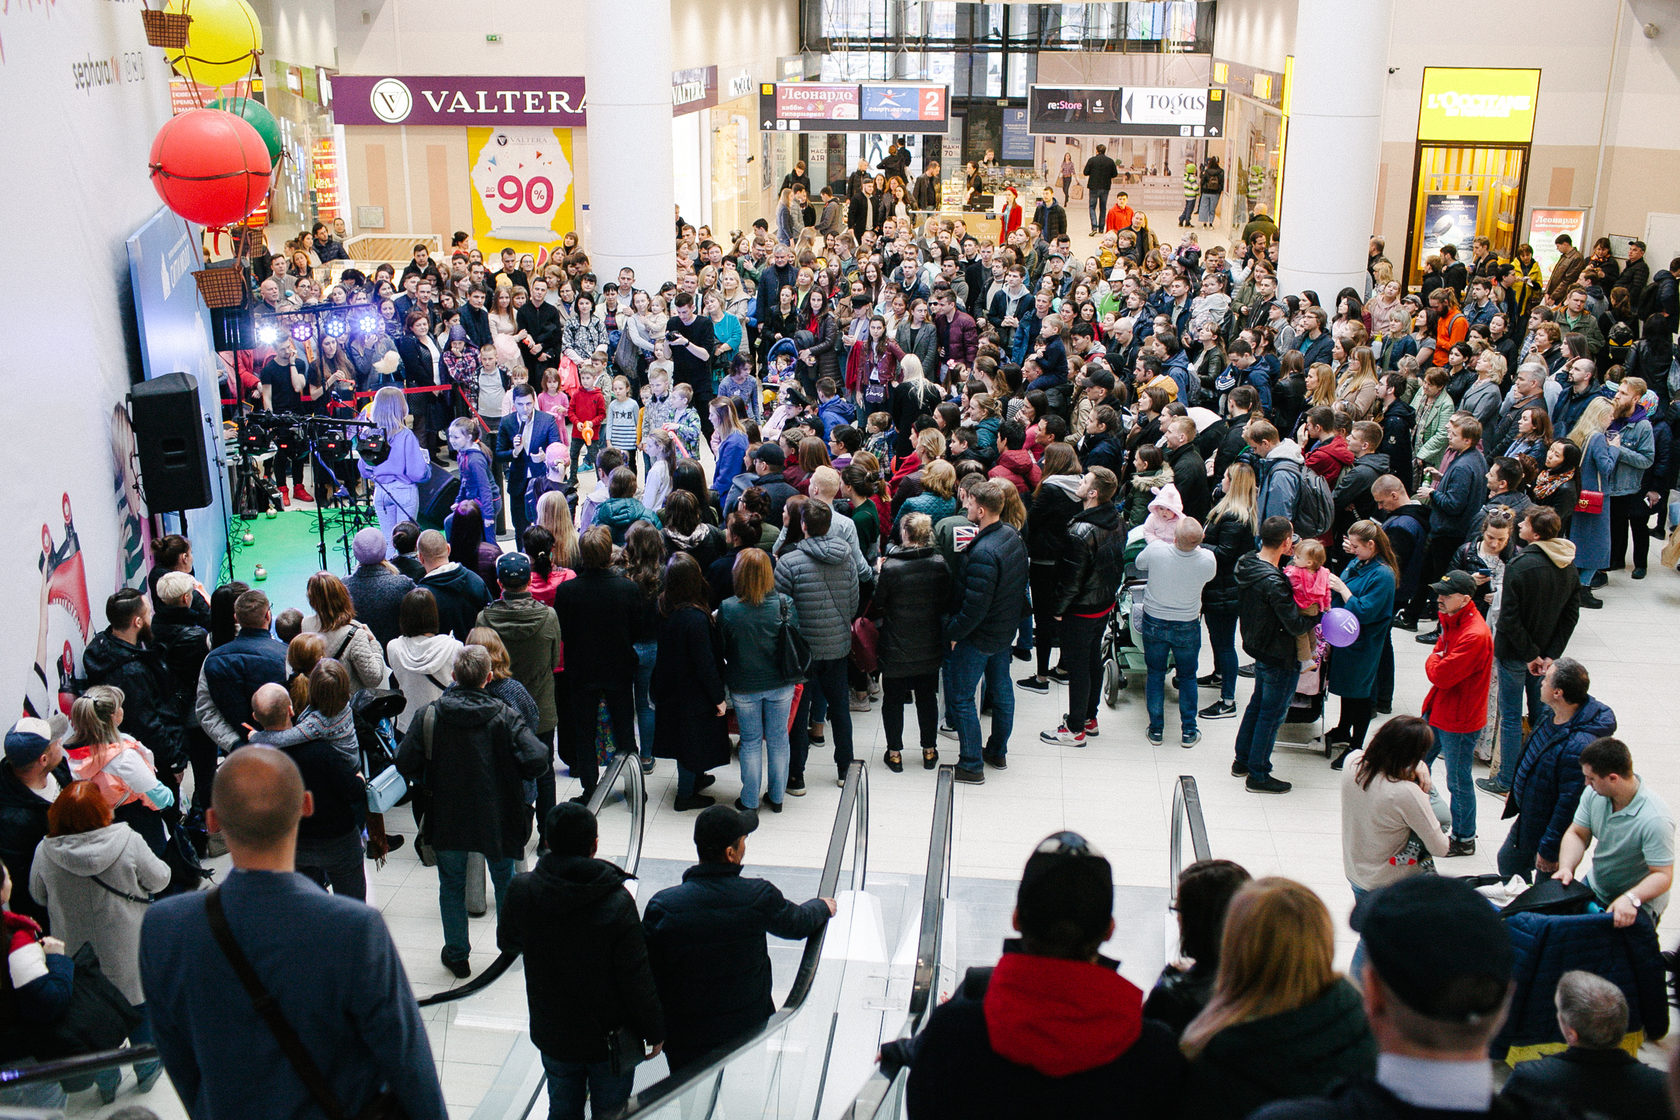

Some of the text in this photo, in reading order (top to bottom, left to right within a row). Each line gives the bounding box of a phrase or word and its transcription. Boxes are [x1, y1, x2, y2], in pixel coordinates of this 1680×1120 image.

[782, 88, 853, 103] Леонардо
[925, 91, 939, 111] 2
[1047, 100, 1082, 110] re:Store
[1146, 93, 1206, 115] Togas
[1535, 215, 1579, 225] Леонардо
